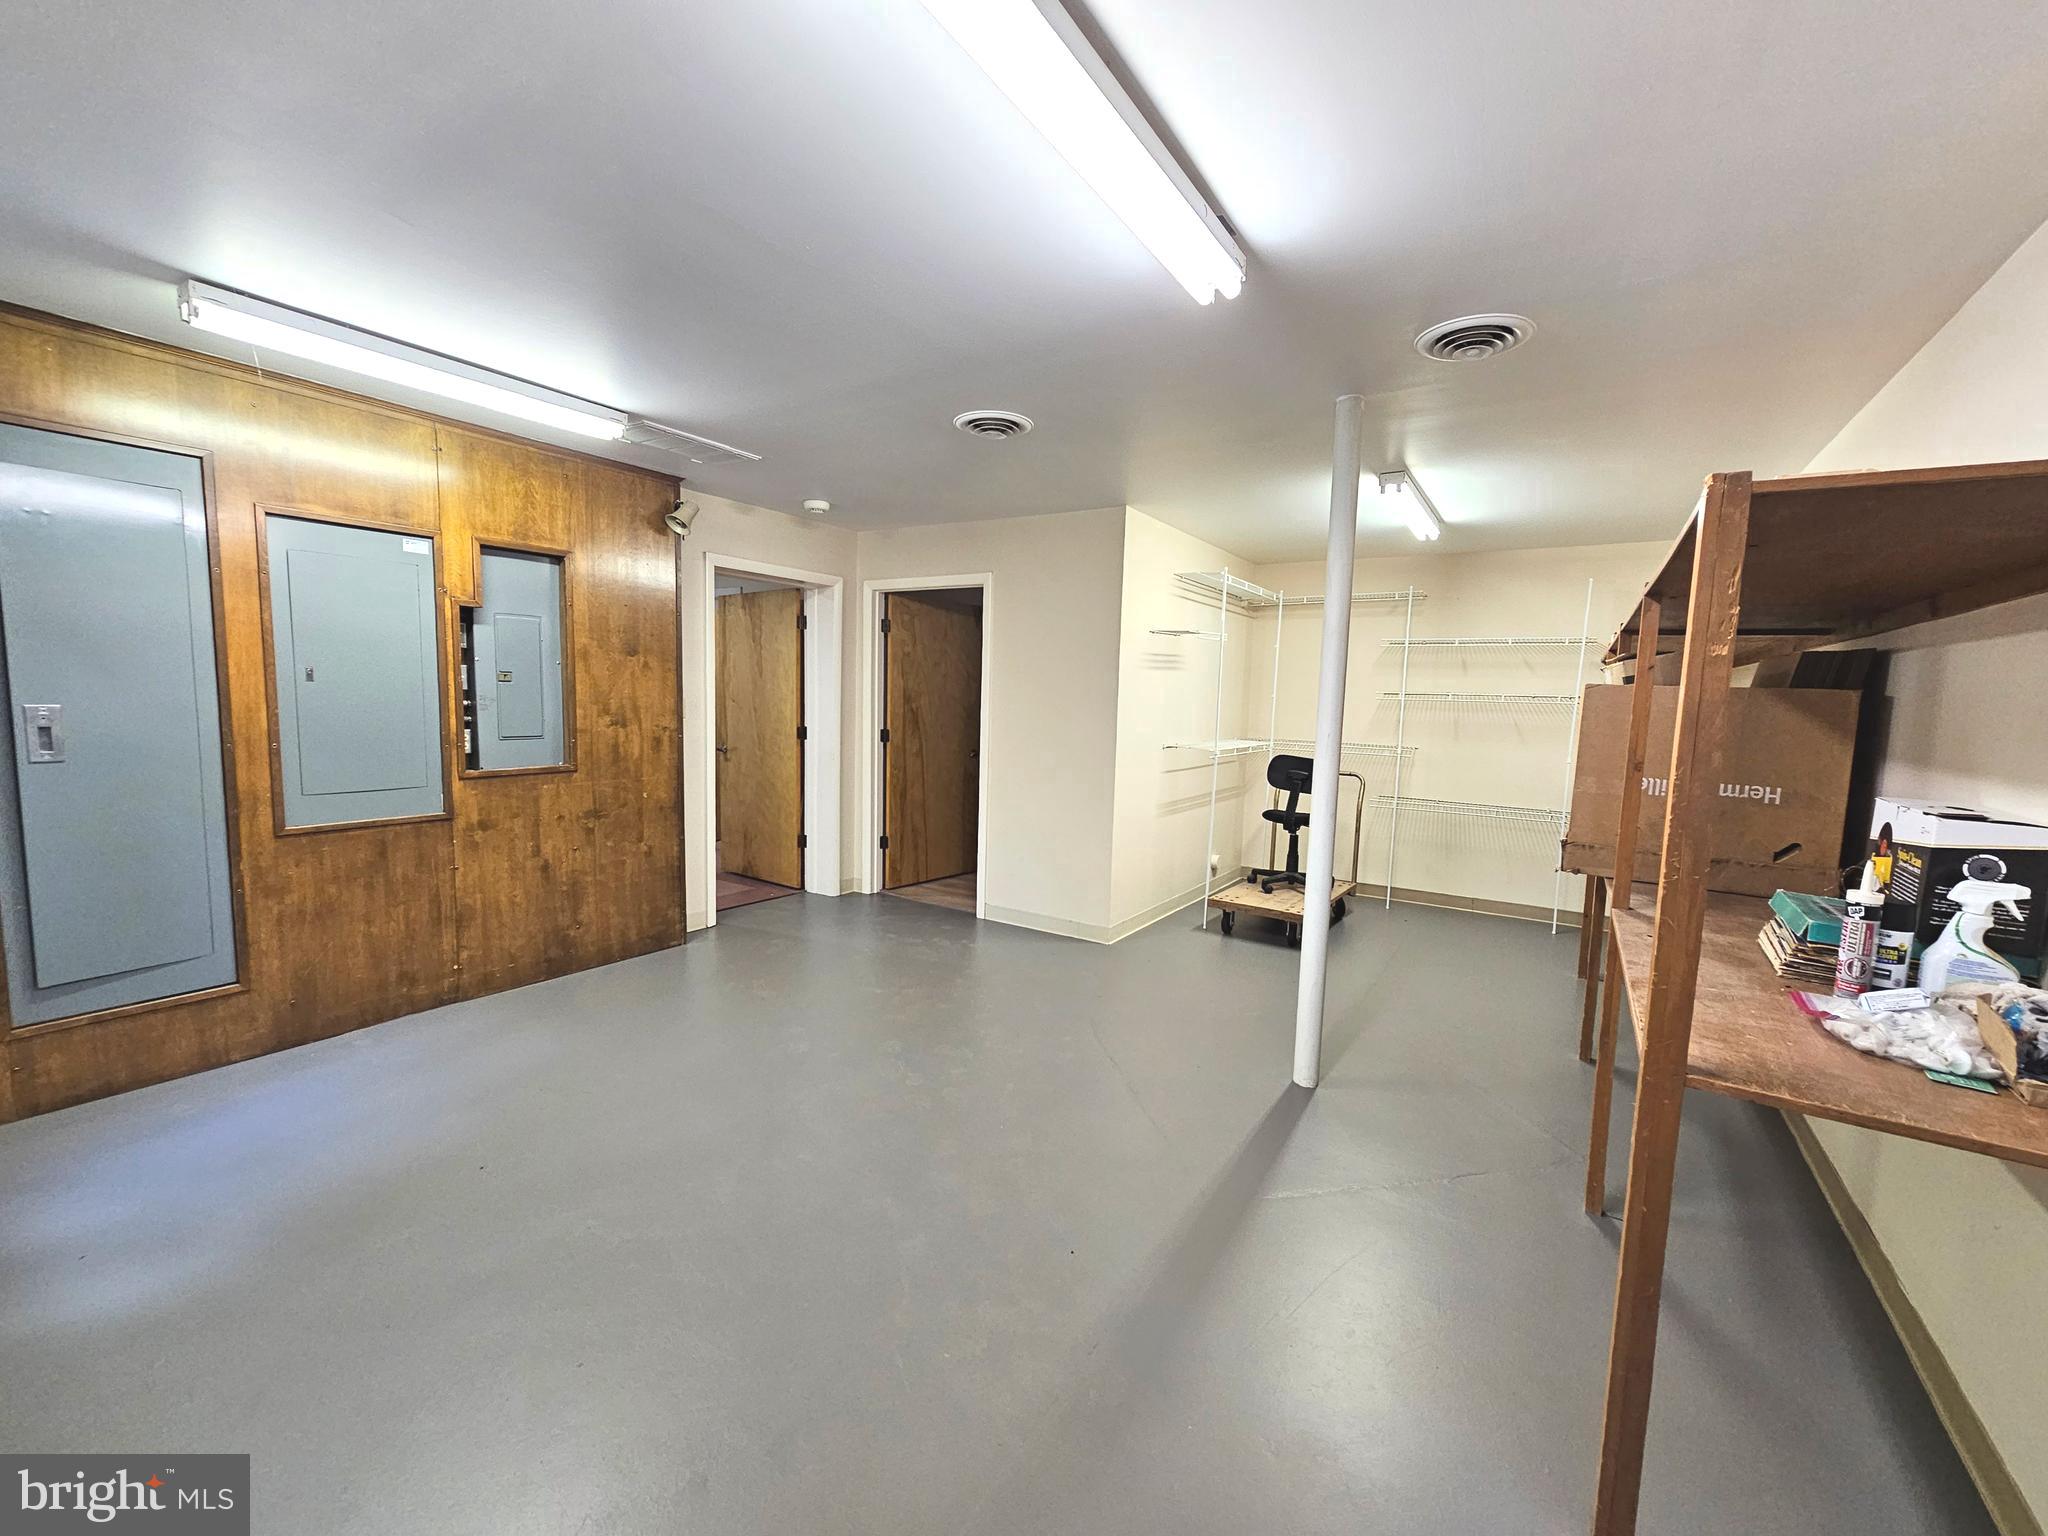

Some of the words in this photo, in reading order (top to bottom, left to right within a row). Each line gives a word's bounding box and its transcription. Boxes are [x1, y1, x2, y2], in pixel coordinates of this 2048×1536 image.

[1641, 777, 1668, 797] ille
[1719, 783, 1782, 805] Herm
[1850, 907, 1863, 915] DAP
[1847, 920, 1860, 953] ULTRA
